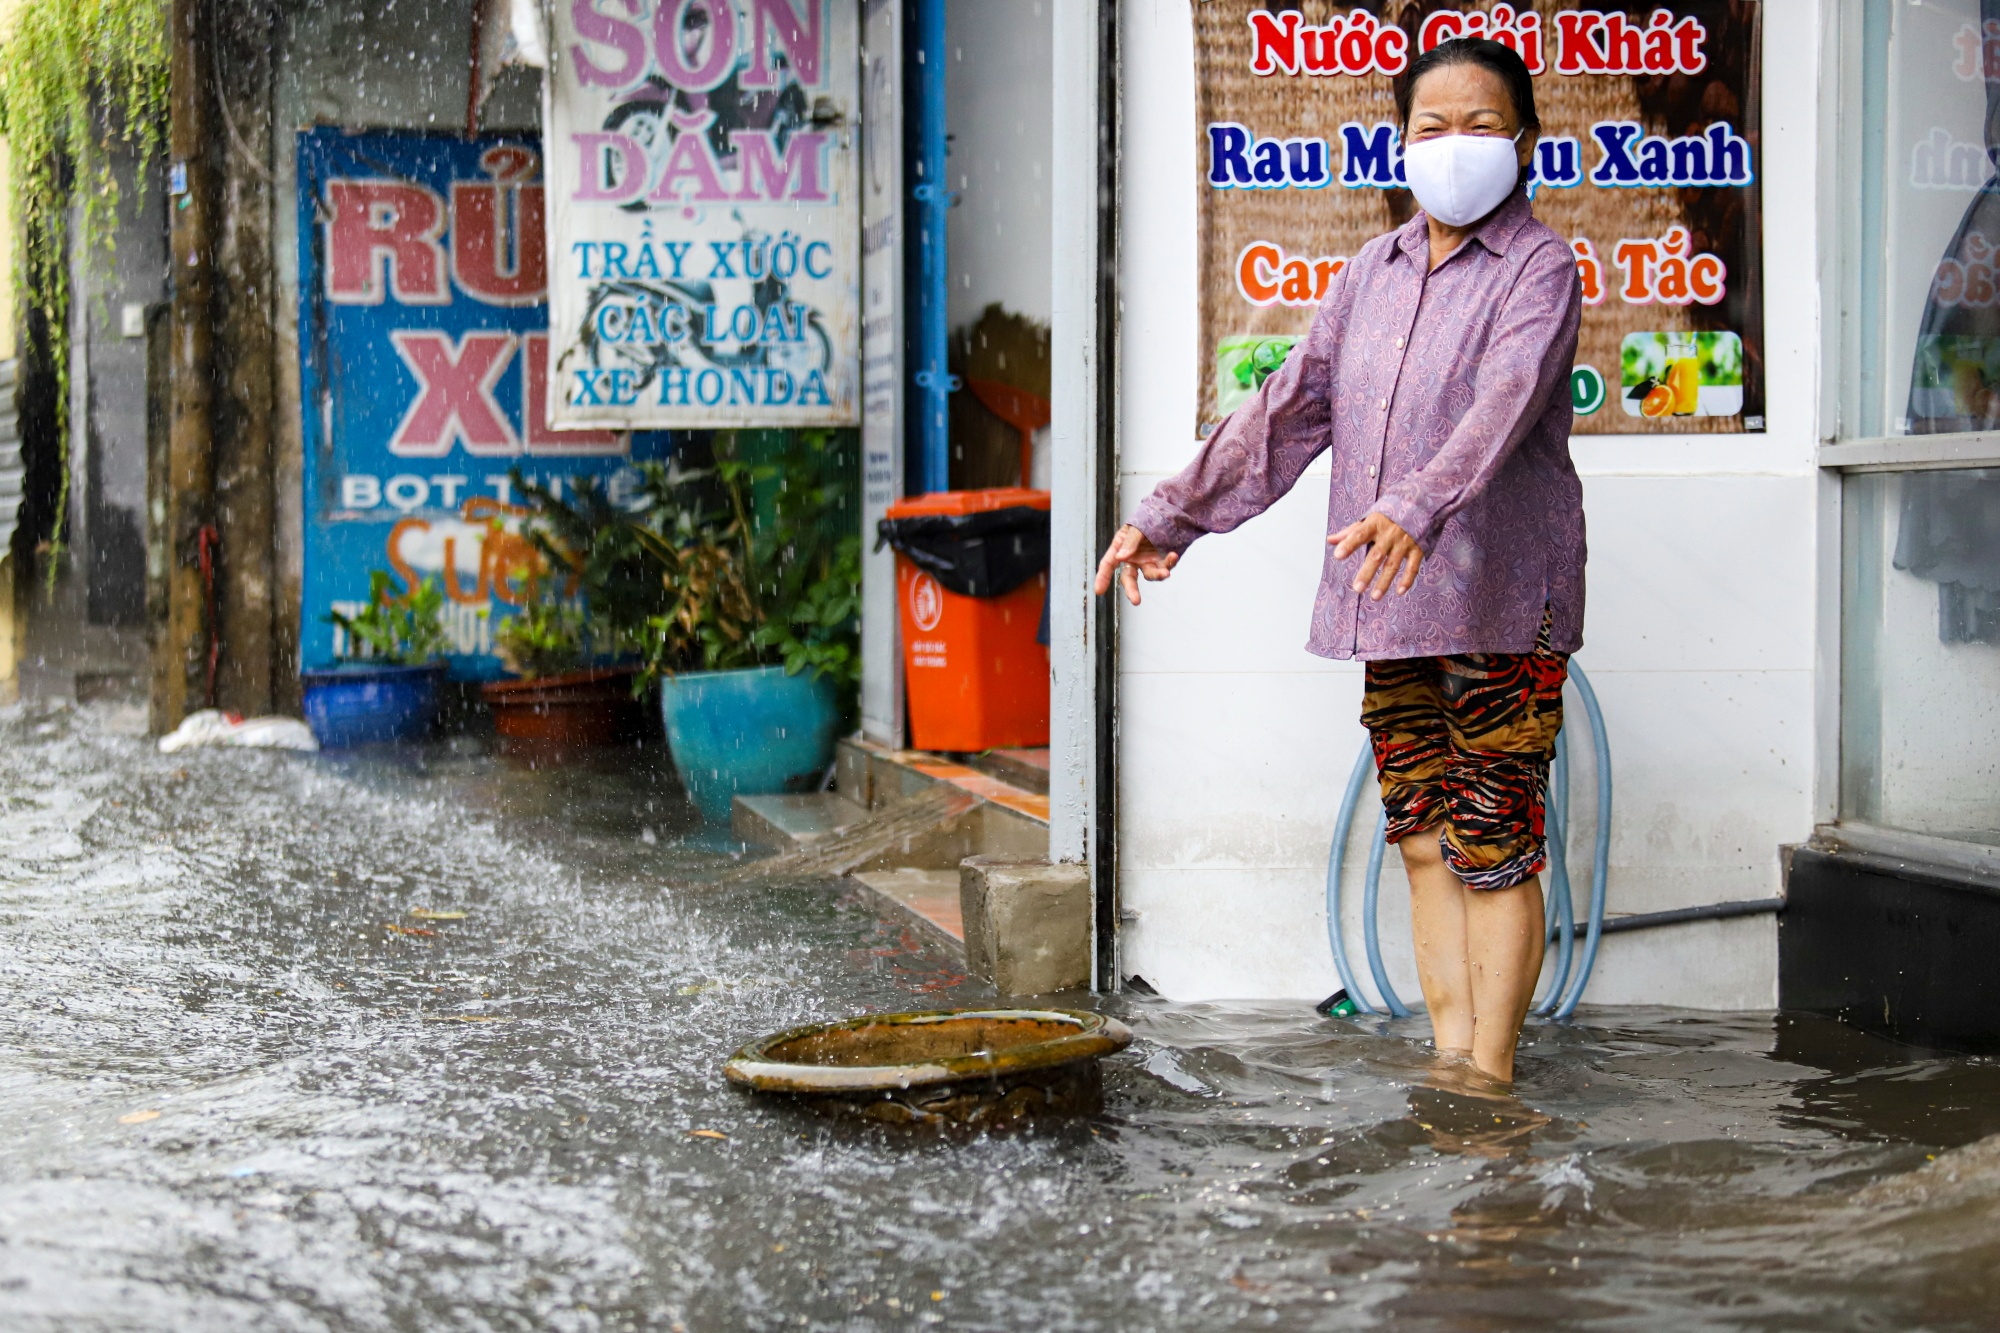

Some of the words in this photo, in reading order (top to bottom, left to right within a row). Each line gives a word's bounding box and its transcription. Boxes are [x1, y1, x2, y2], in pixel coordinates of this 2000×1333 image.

[1250, 12, 1407, 73] Nước
[1556, 11, 1706, 73] Khát
[571, 111, 828, 219] DẶM
[1209, 125, 1326, 185] Rau
[1342, 125, 1407, 185] M
[1594, 123, 1748, 184] Xanh
[572, 219, 692, 279] TRẦY
[708, 230, 833, 280] XƯỚC
[1615, 229, 1722, 301] Tắc
[597, 295, 687, 343] CÁC
[572, 368, 639, 406] XE
[656, 368, 833, 406] HONDA
